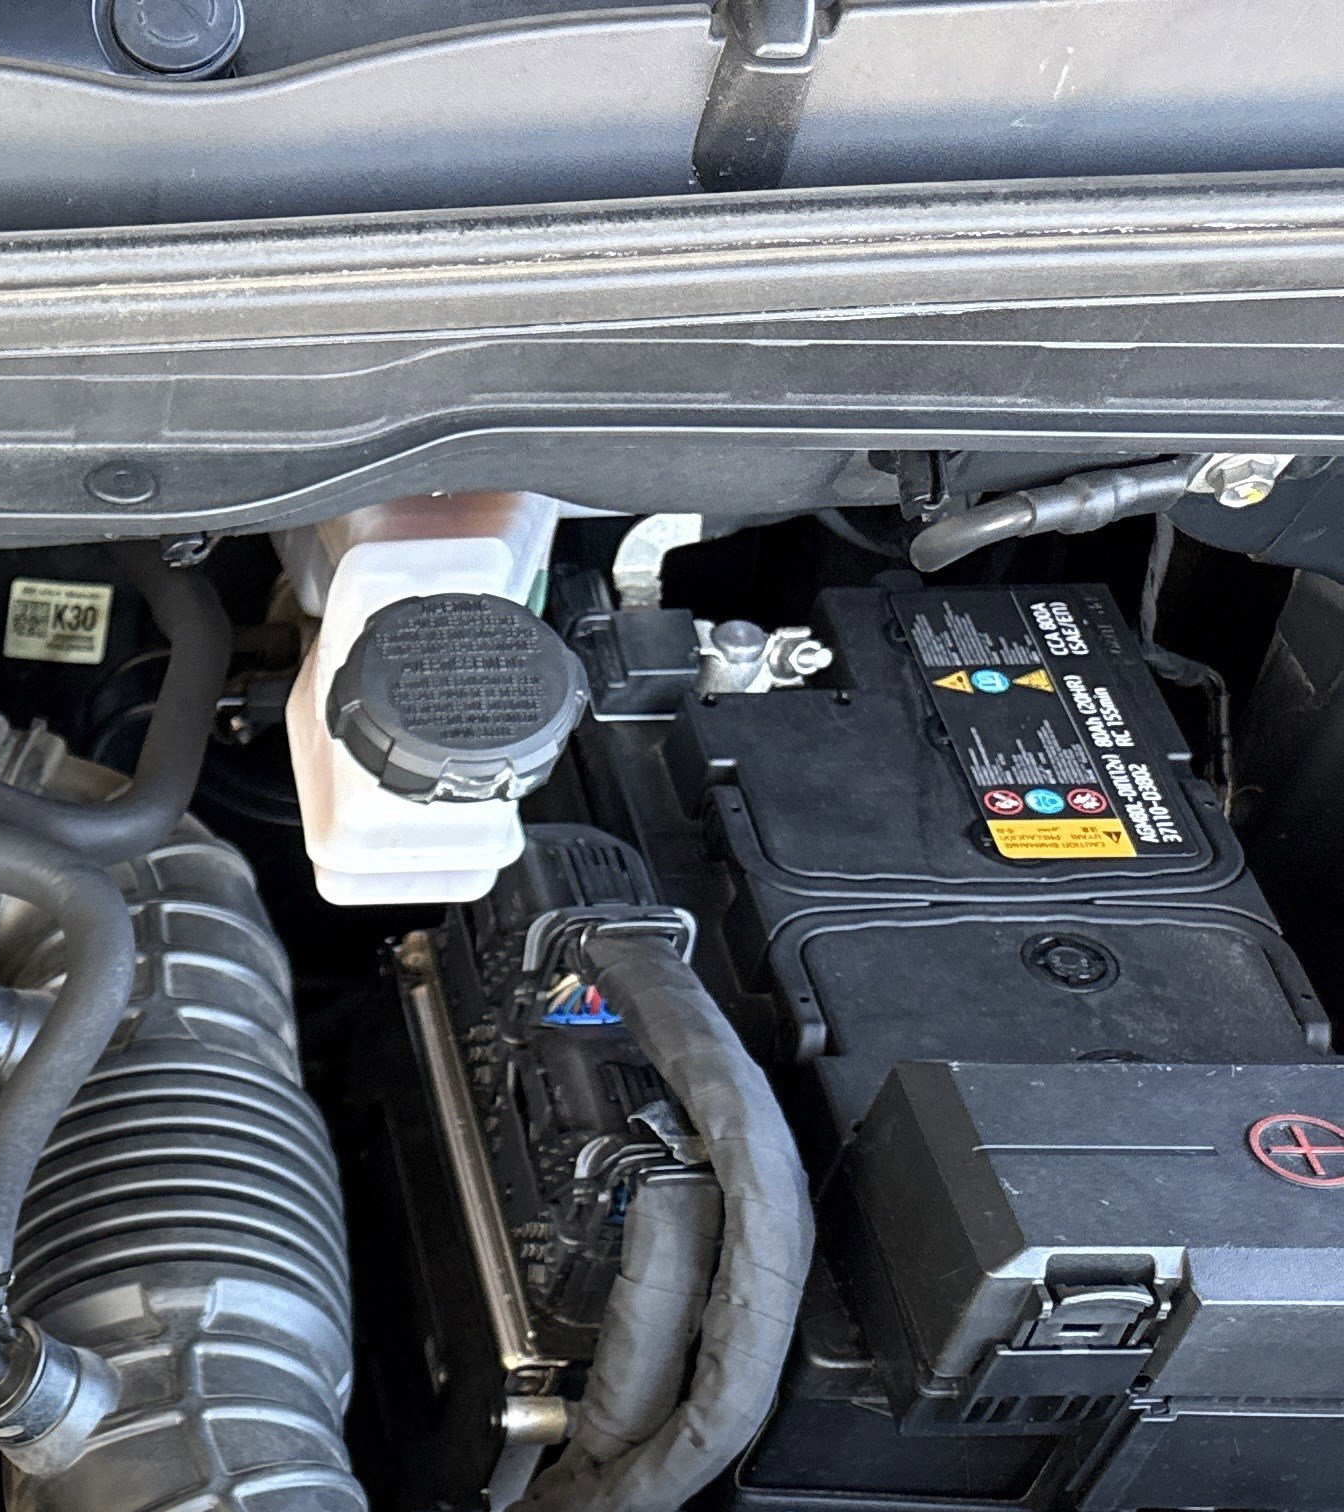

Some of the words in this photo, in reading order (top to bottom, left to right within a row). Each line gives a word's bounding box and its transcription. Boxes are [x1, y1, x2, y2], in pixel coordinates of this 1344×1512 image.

[52, 602, 98, 632] K30
[1029, 601, 1057, 632] 800A
[1044, 630, 1069, 657] CCA
[1092, 686, 1125, 728] 155min
[1084, 714, 1114, 749] 80Ah
[1110, 728, 1135, 748] RC
[1127, 761, 1183, 844] 37110-D3802
